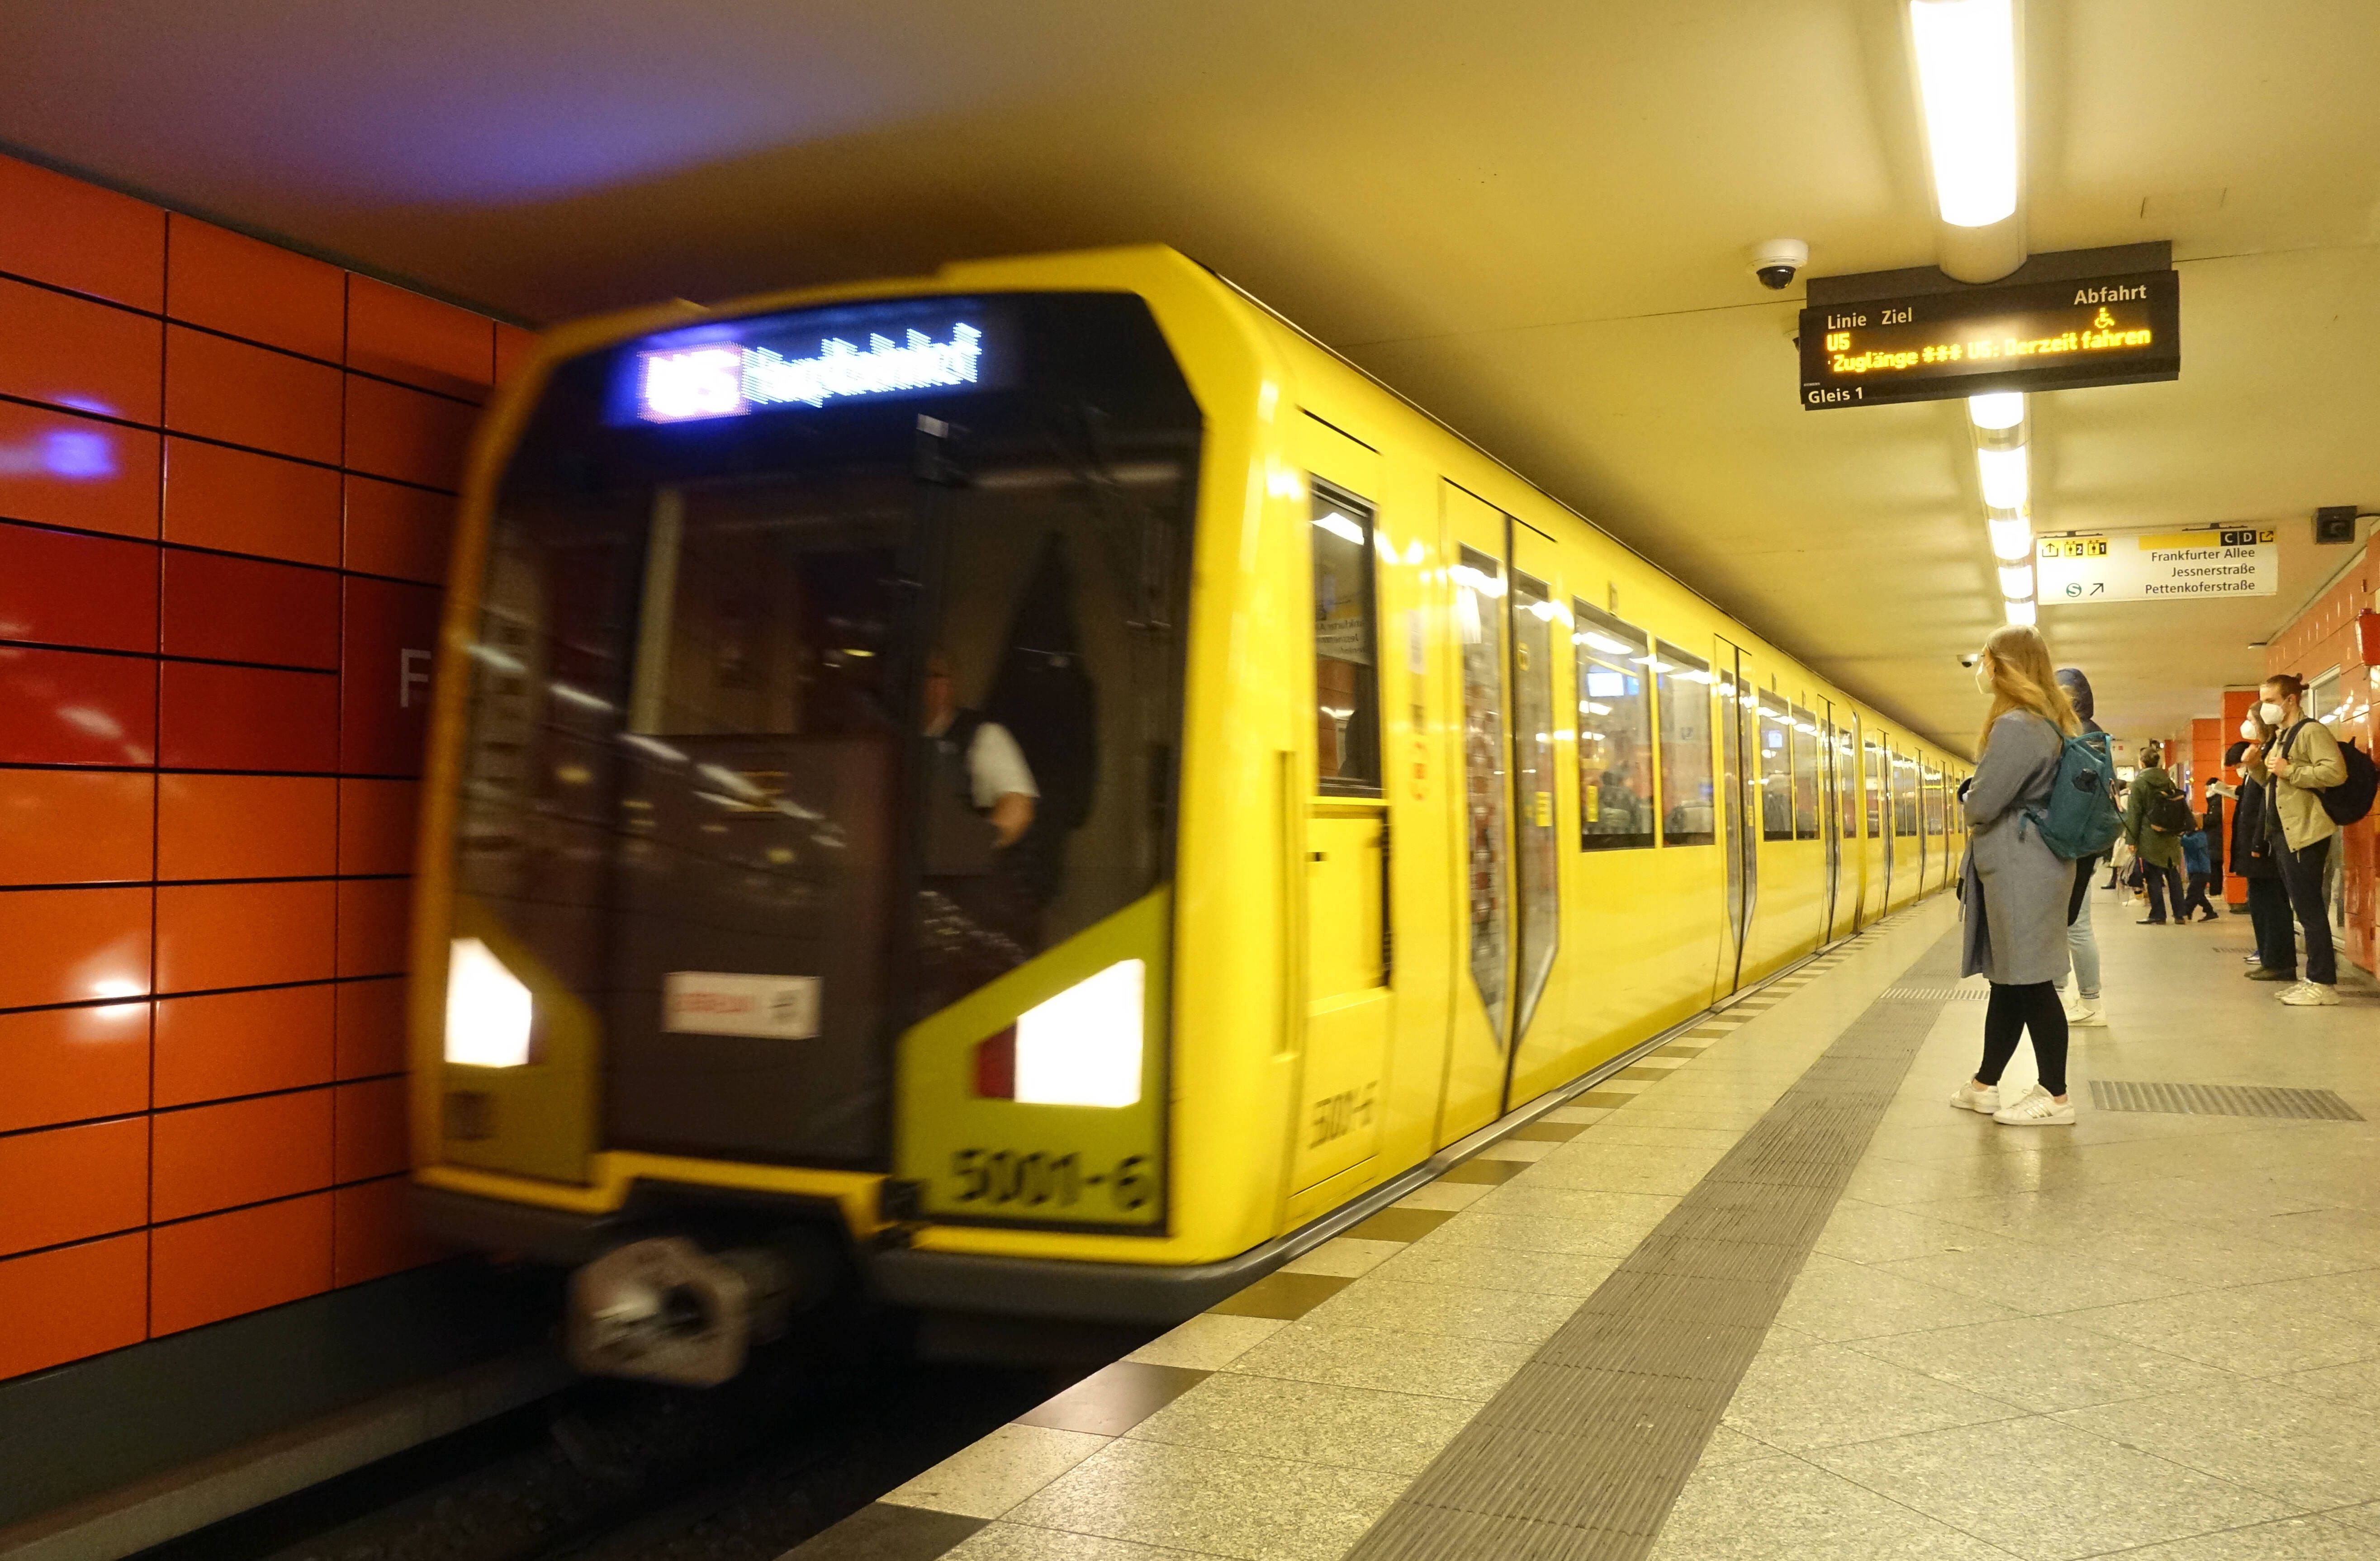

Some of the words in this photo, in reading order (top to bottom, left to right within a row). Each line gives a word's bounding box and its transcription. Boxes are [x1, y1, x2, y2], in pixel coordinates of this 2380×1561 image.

[2074, 284, 2147, 305] Abfahrt
[1828, 312, 1867, 329] Linie
[1882, 307, 1912, 325] Ziel
[1827, 332, 1850, 351] U5
[1834, 351, 1919, 373] Zuglänge
[2005, 332, 2077, 356] Derzeit
[2081, 329, 2151, 349] fahren
[1808, 388, 1850, 403] Gleis
[1855, 387, 1863, 399] 1
[2224, 533, 2233, 543] C
[2243, 532, 2252, 542] D
[2151, 549, 2220, 562] Frankfurter
[2224, 548, 2255, 558] Allee
[2171, 563, 2255, 577] Jessnerstraße
[2145, 580, 2255, 594] Pettenkoferstraße
